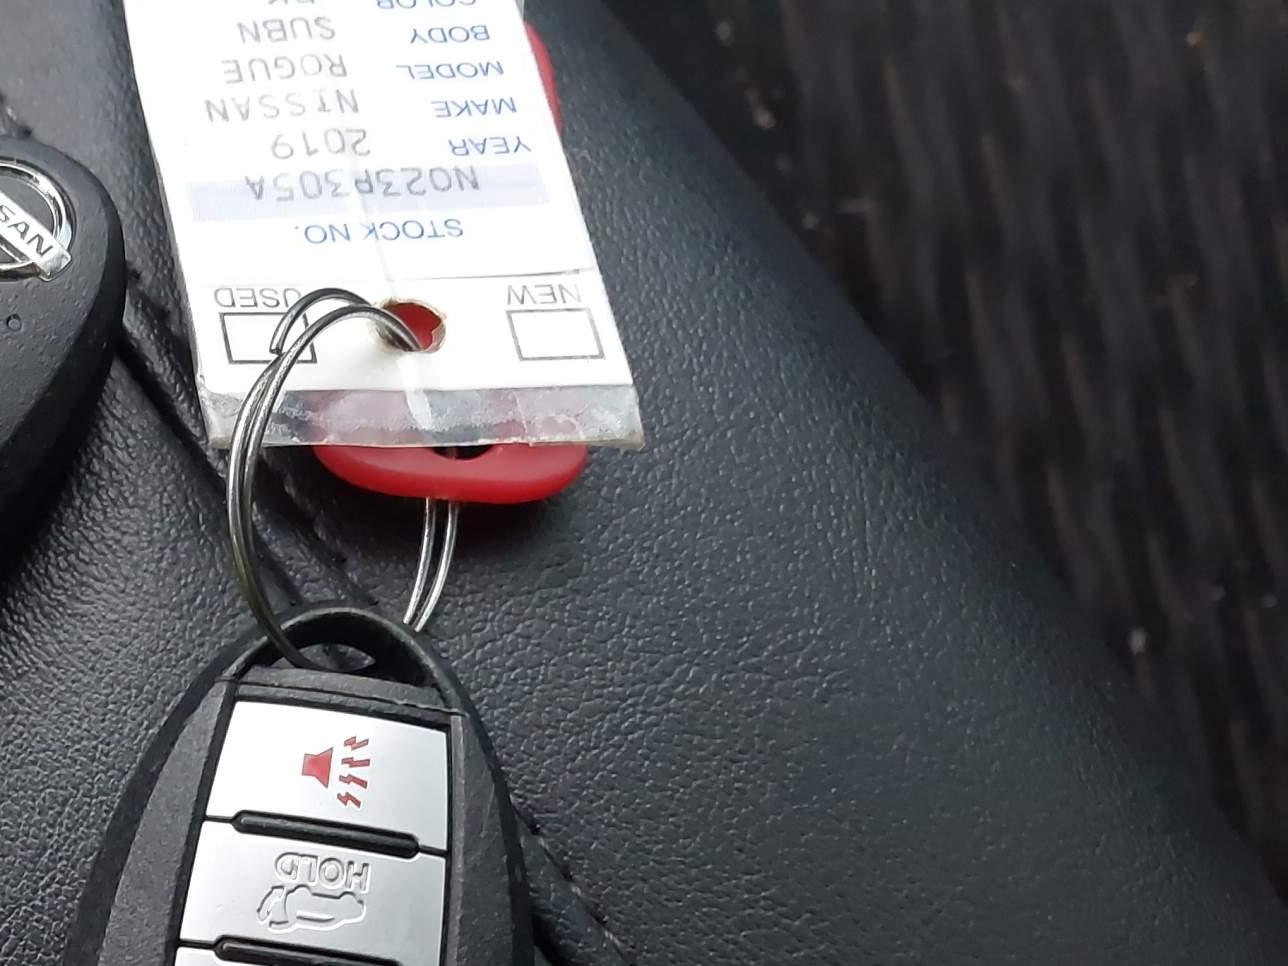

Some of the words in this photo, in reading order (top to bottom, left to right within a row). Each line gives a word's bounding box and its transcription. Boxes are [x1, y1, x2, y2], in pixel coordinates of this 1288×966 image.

[239, 16, 336, 43] SUBN
[410, 24, 490, 44] BODY
[222, 53, 348, 84] ROGUE
[396, 60, 504, 78] MODEL
[206, 88, 360, 122] NISSAN
[432, 97, 517, 118] MAKE
[271, 128, 372, 159] 2019
[449, 136, 531, 157] YEAR
[295, 222, 351, 244] NO.
[363, 218, 464, 240] STOCK
[214, 288, 302, 308] USED
[507, 283, 583, 306] NEW
[275, 852, 370, 893] HOLD
